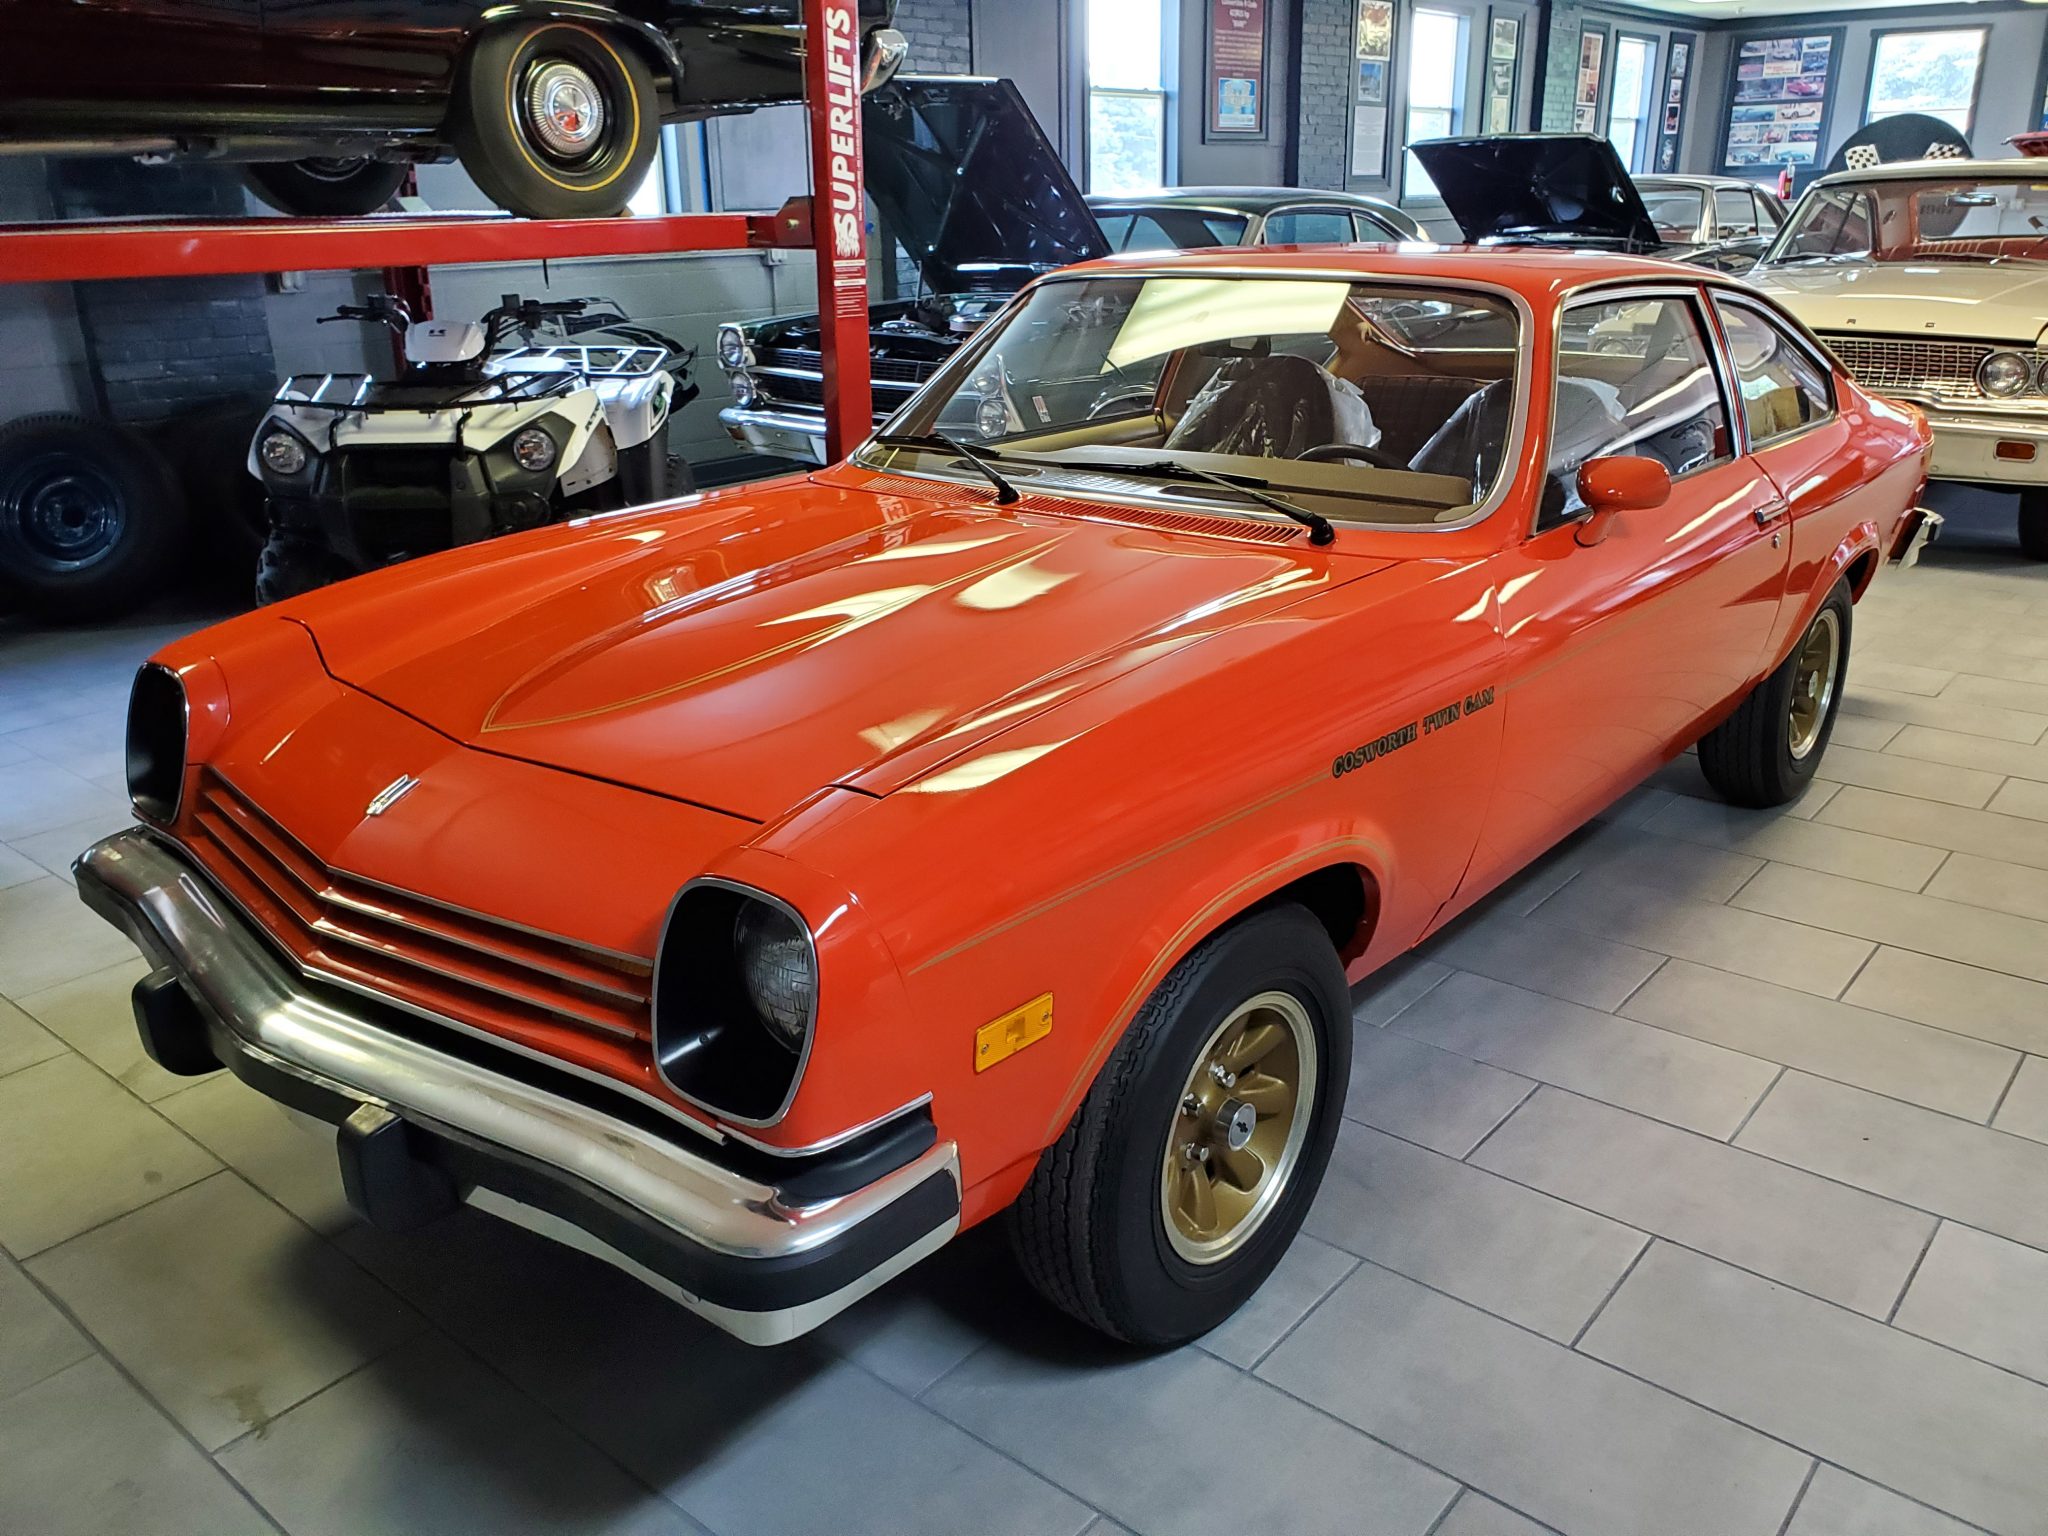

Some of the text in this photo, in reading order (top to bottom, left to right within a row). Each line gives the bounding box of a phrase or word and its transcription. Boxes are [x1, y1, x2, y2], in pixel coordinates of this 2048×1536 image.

[825, 7, 860, 258] SUPERLIFTS
[1332, 685, 1495, 779] COSWORTH TWIN CAM
